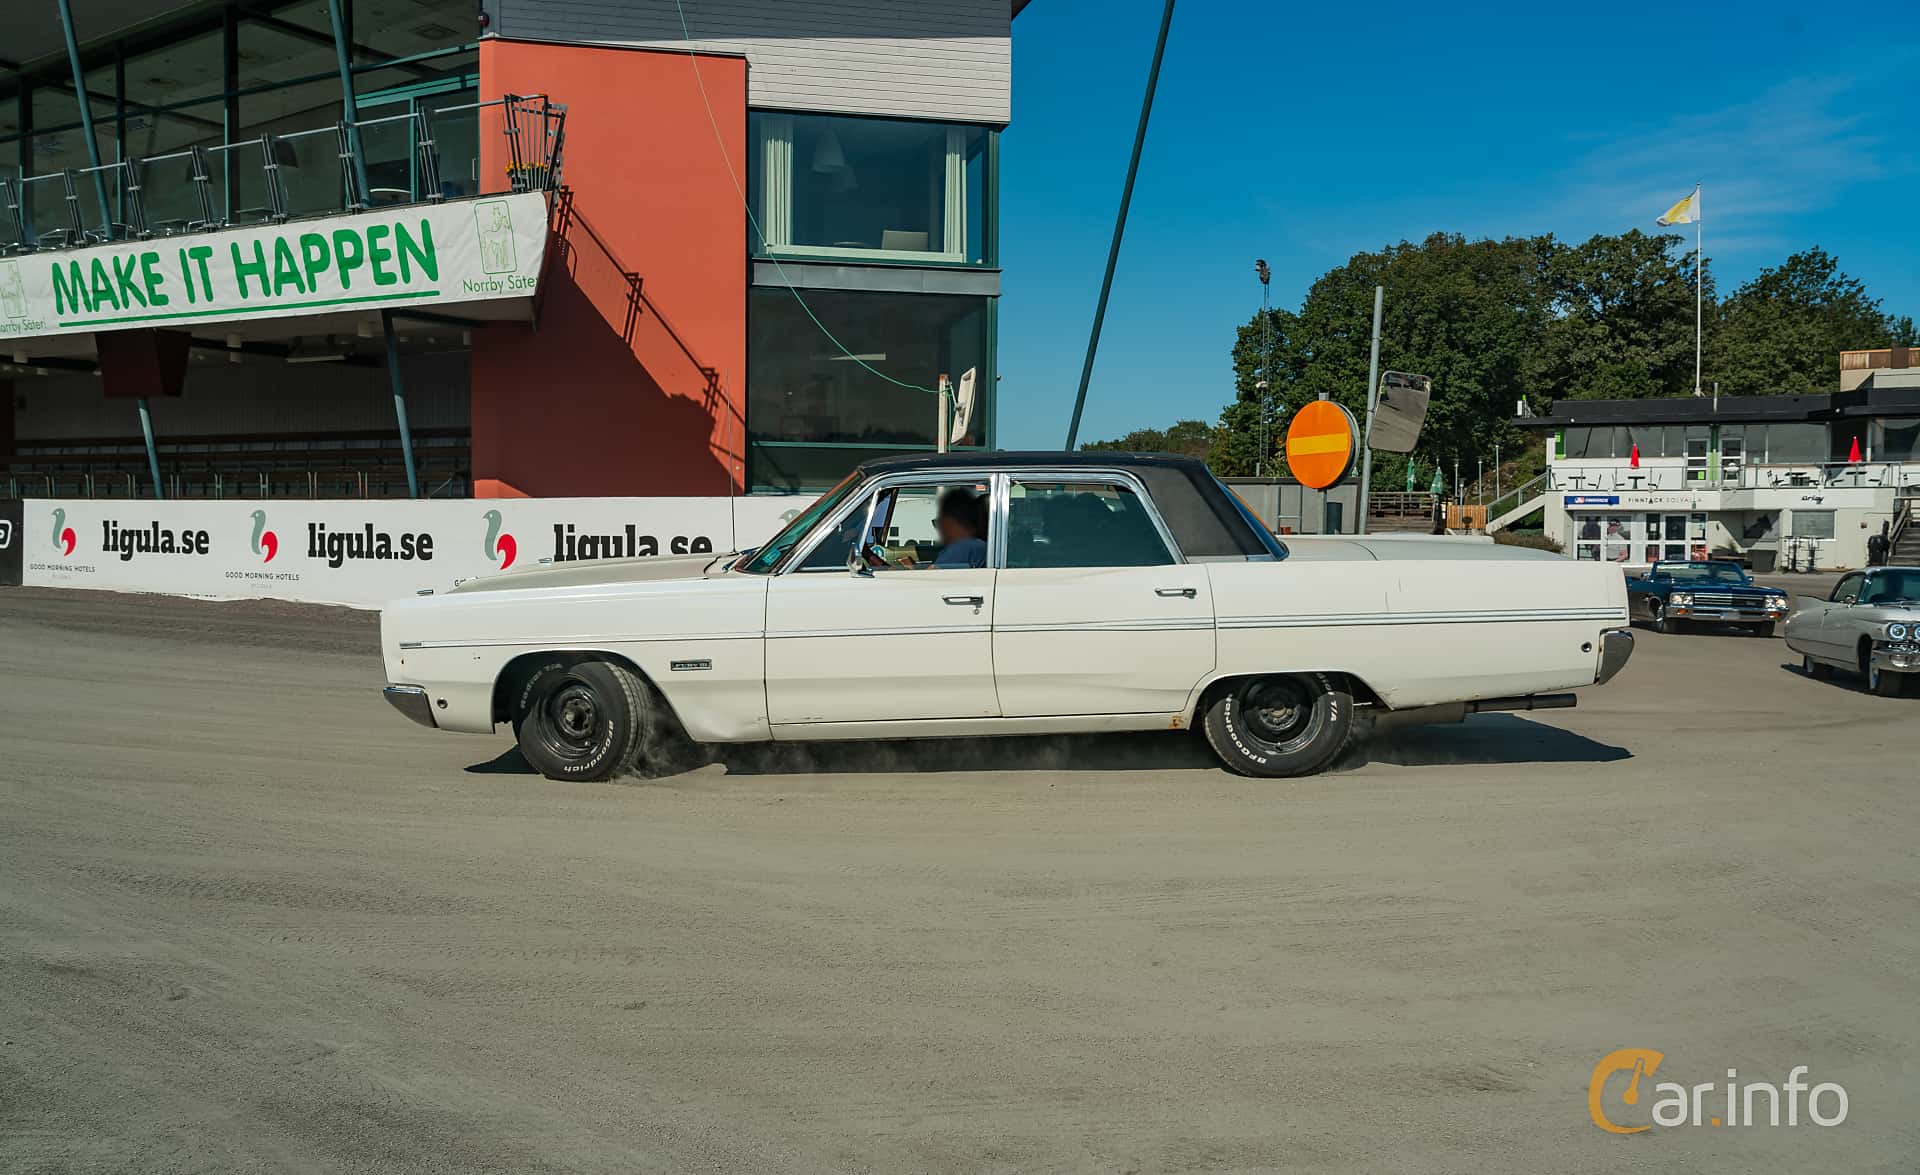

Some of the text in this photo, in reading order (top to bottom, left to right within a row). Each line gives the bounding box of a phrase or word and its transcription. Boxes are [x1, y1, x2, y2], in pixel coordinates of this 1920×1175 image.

[51, 218, 440, 315] MAKE IT HAPPEN
[462, 275, 504, 295] Norrby
[102, 520, 210, 562] ligula.se
[307, 522, 434, 568] ligula.se
[47, 564, 73, 572] MORNING
[74, 565, 96, 573] HOTELS
[225, 571, 300, 581] GOOD MORNING HOTELS
